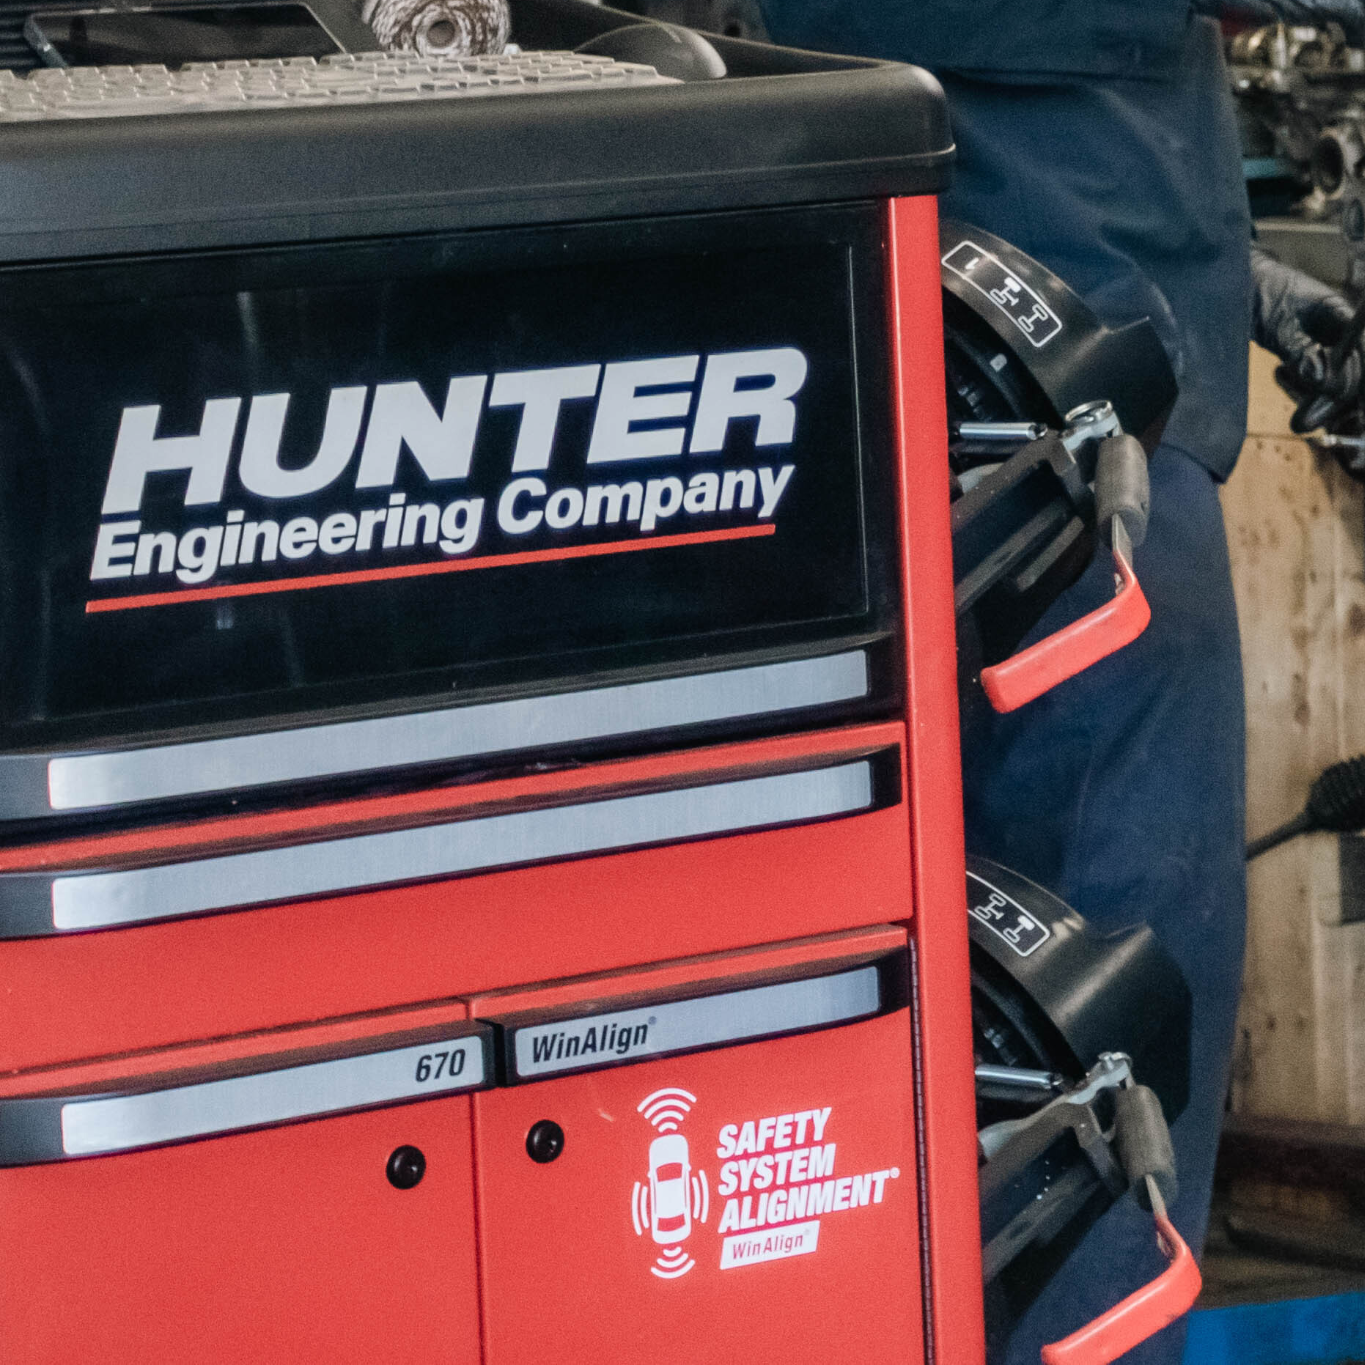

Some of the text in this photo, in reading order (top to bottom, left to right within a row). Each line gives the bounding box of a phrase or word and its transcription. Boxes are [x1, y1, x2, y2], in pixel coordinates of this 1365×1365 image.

[102, 346, 807, 515] HUNTER
[498, 463, 794, 536] Company
[91, 492, 486, 583] Engineering
[415, 1048, 466, 1083] 670
[716, 1107, 832, 1159] SAFETY
[717, 1143, 837, 1196] SYSTEM
